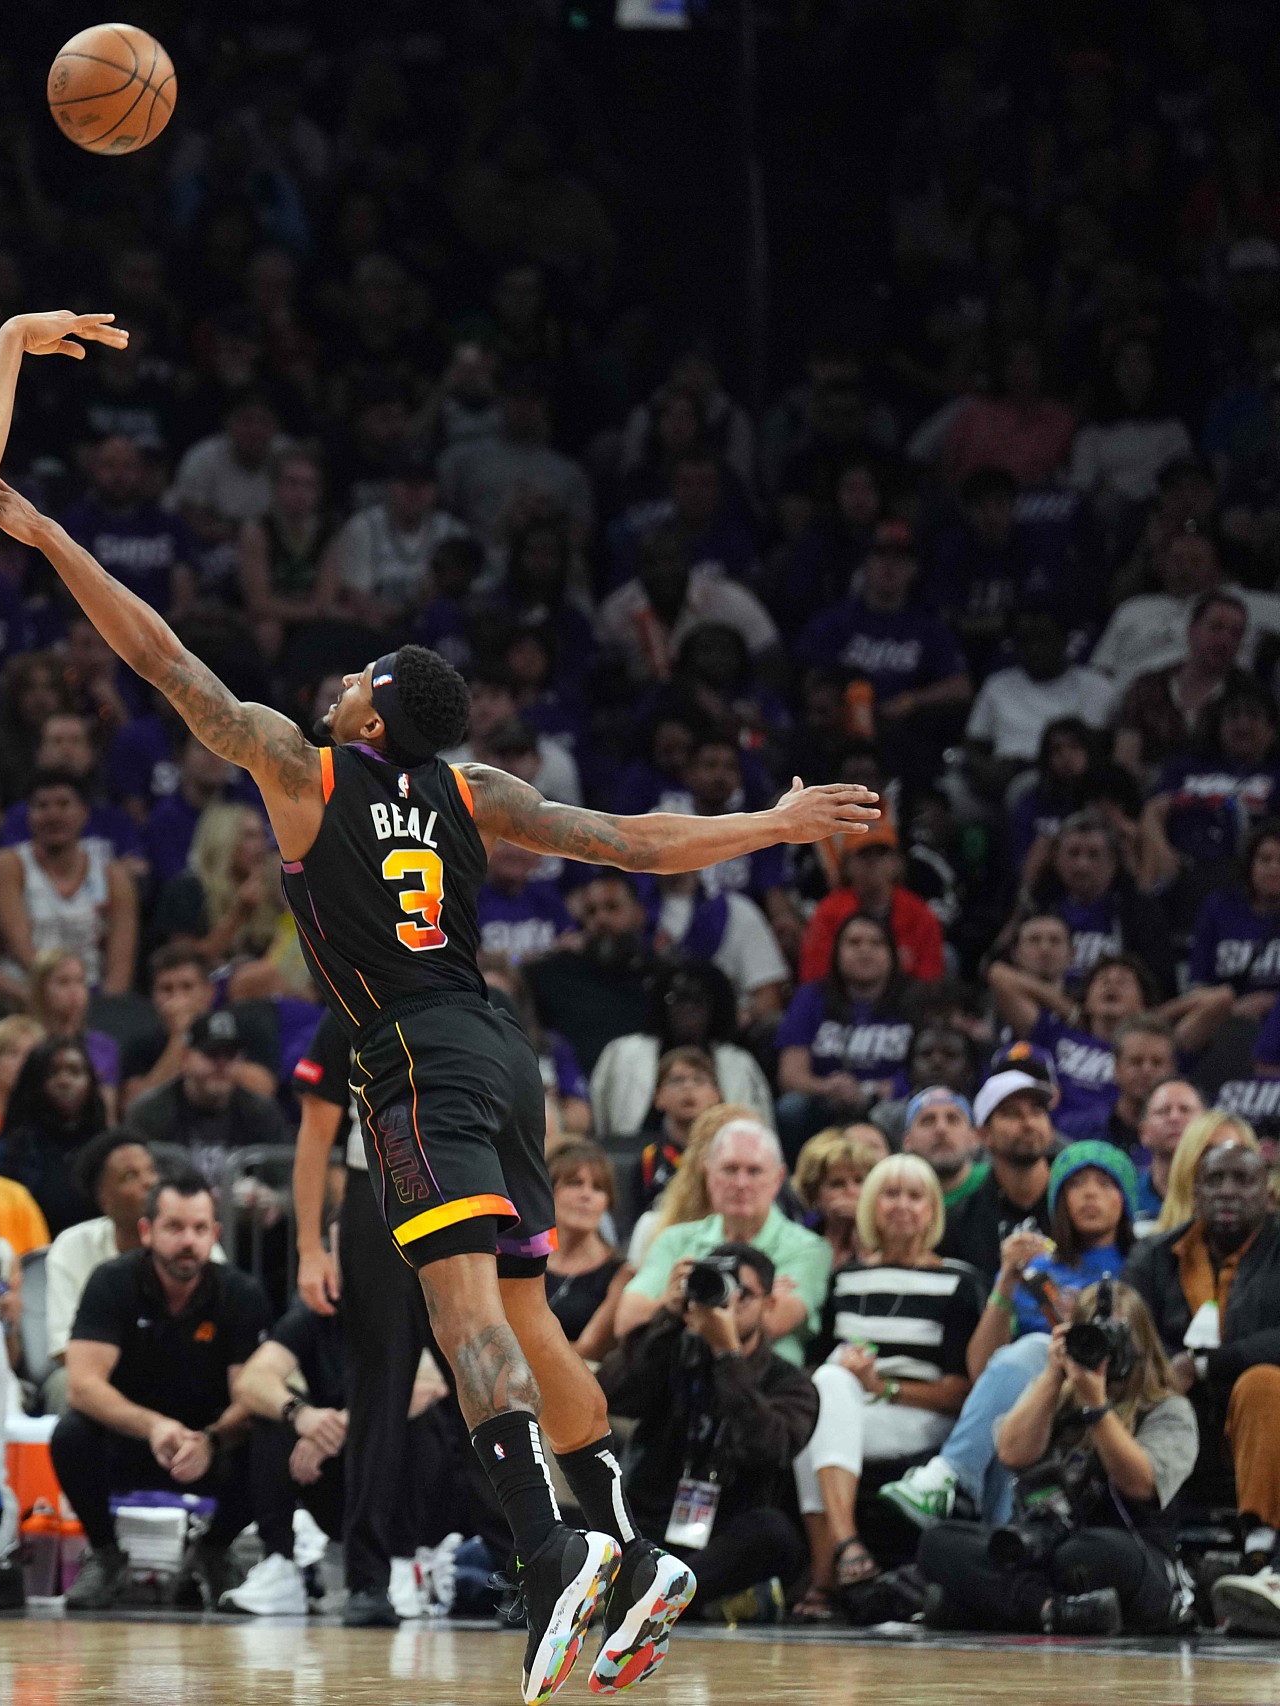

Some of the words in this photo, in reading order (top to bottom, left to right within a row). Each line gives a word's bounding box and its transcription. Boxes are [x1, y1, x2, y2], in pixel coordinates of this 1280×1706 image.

[370, 802, 438, 849] BEAL
[381, 848, 449, 952] 3
[378, 1104, 430, 1204] SUNS
